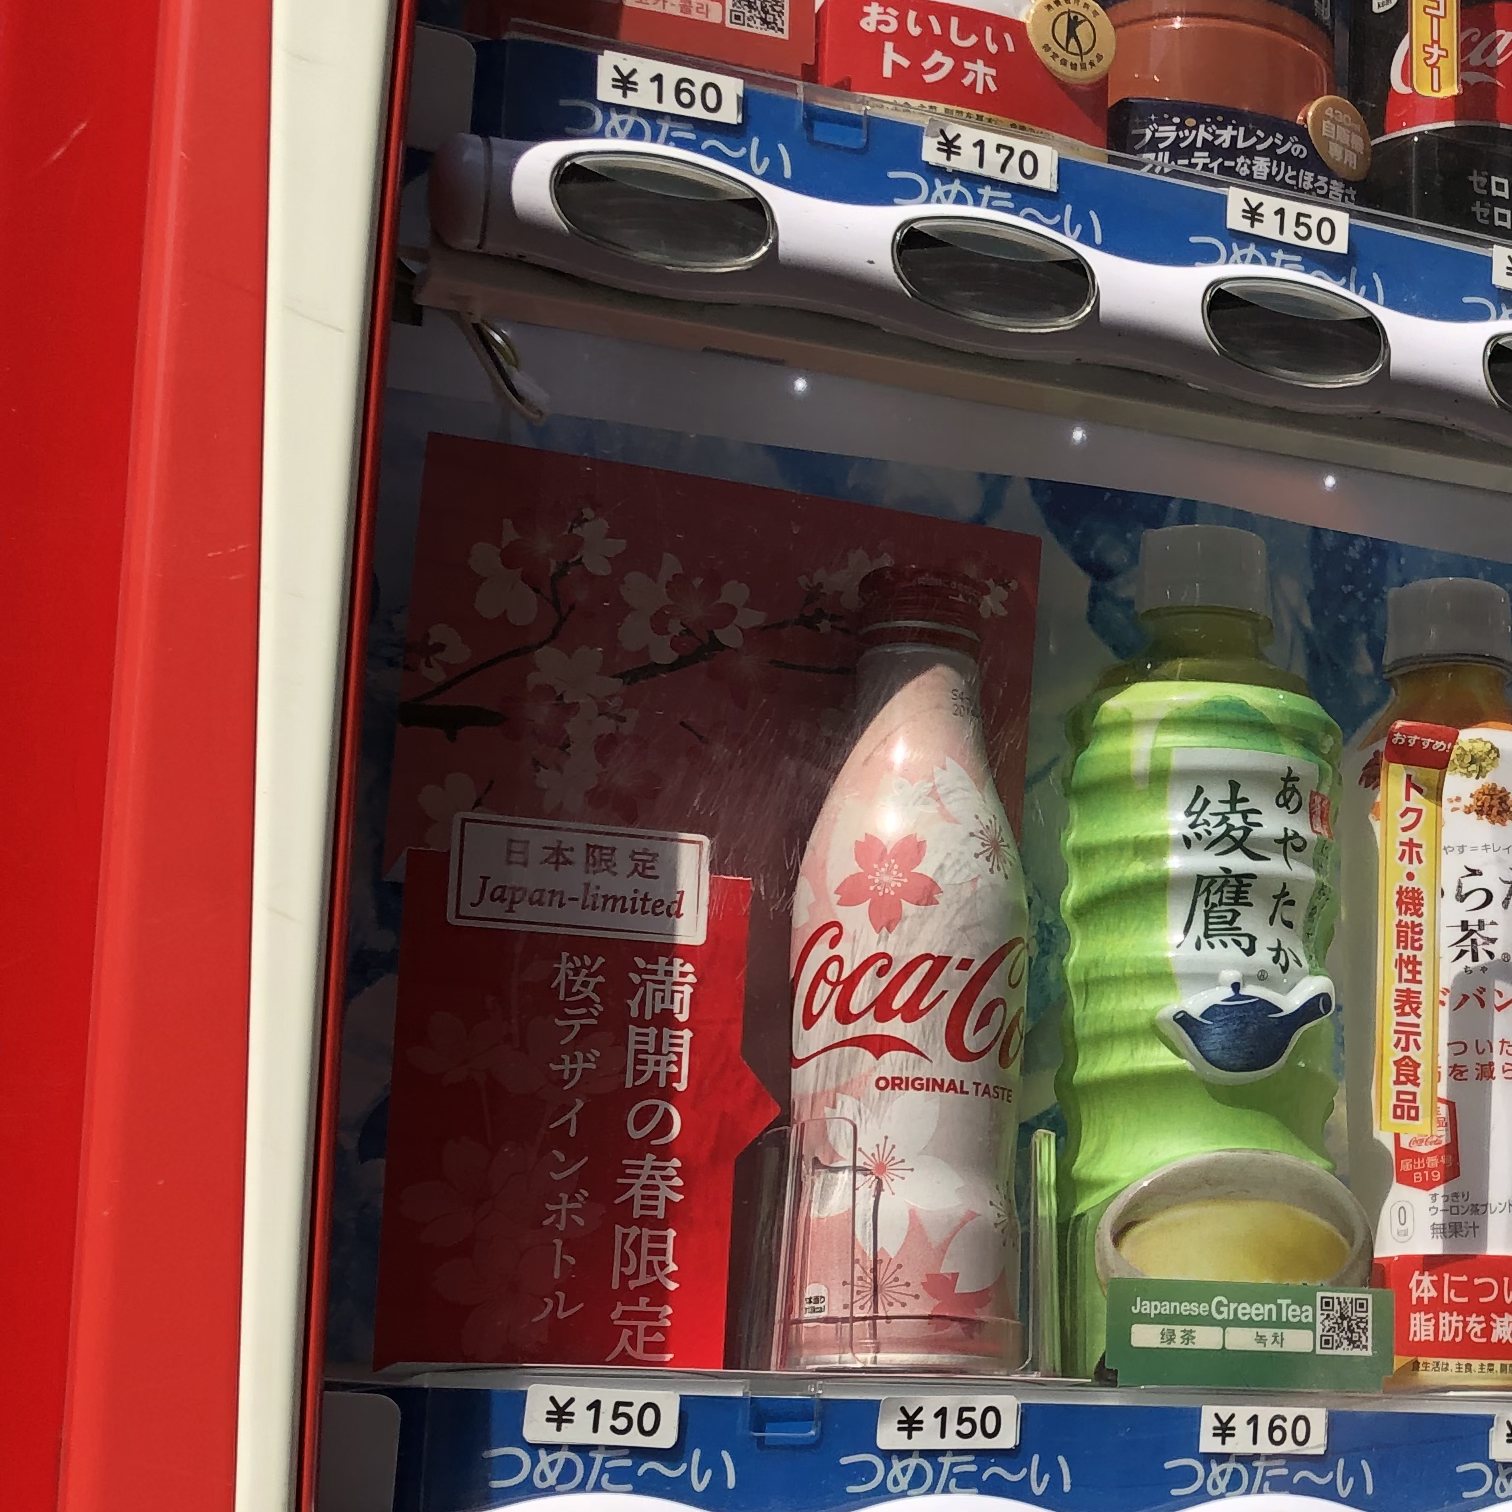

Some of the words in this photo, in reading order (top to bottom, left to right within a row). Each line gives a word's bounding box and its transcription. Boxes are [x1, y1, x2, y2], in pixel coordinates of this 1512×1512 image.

[859, 6, 1016, 55] おいしい
[611, 64, 723, 114] ¥160
[882, 42, 999, 96] トクホ
[937, 128, 1039, 180] ¥170
[1131, 121, 1308, 159] ブラッドオレンジの
[1241, 197, 1337, 246] ¥150
[1391, 732, 1452, 753] おすすめ!
[503, 837, 663, 881] 日本限定
[1181, 779, 1271, 956] 綾鷹
[1269, 765, 1308, 977] あやたか
[470, 874, 685, 920] Japan-limited
[1446, 919, 1499, 963] 茶
[874, 1075, 970, 1097] ORIGINAL
[972, 1081, 1013, 1104] TASTE
[531, 951, 606, 1323] 桜デザインボトル
[605, 955, 698, 1363] 満開の春限定
[1413, 1171, 1441, 1183] B19
[1430, 1222, 1480, 1239] 無果汁
[1131, 1296, 1209, 1318] Japanese
[1254, 1331, 1285, 1348] 녹차
[544, 1395, 662, 1438] ¥150
[896, 1405, 1002, 1440] ¥150
[1212, 1412, 1311, 1447] ¥160
